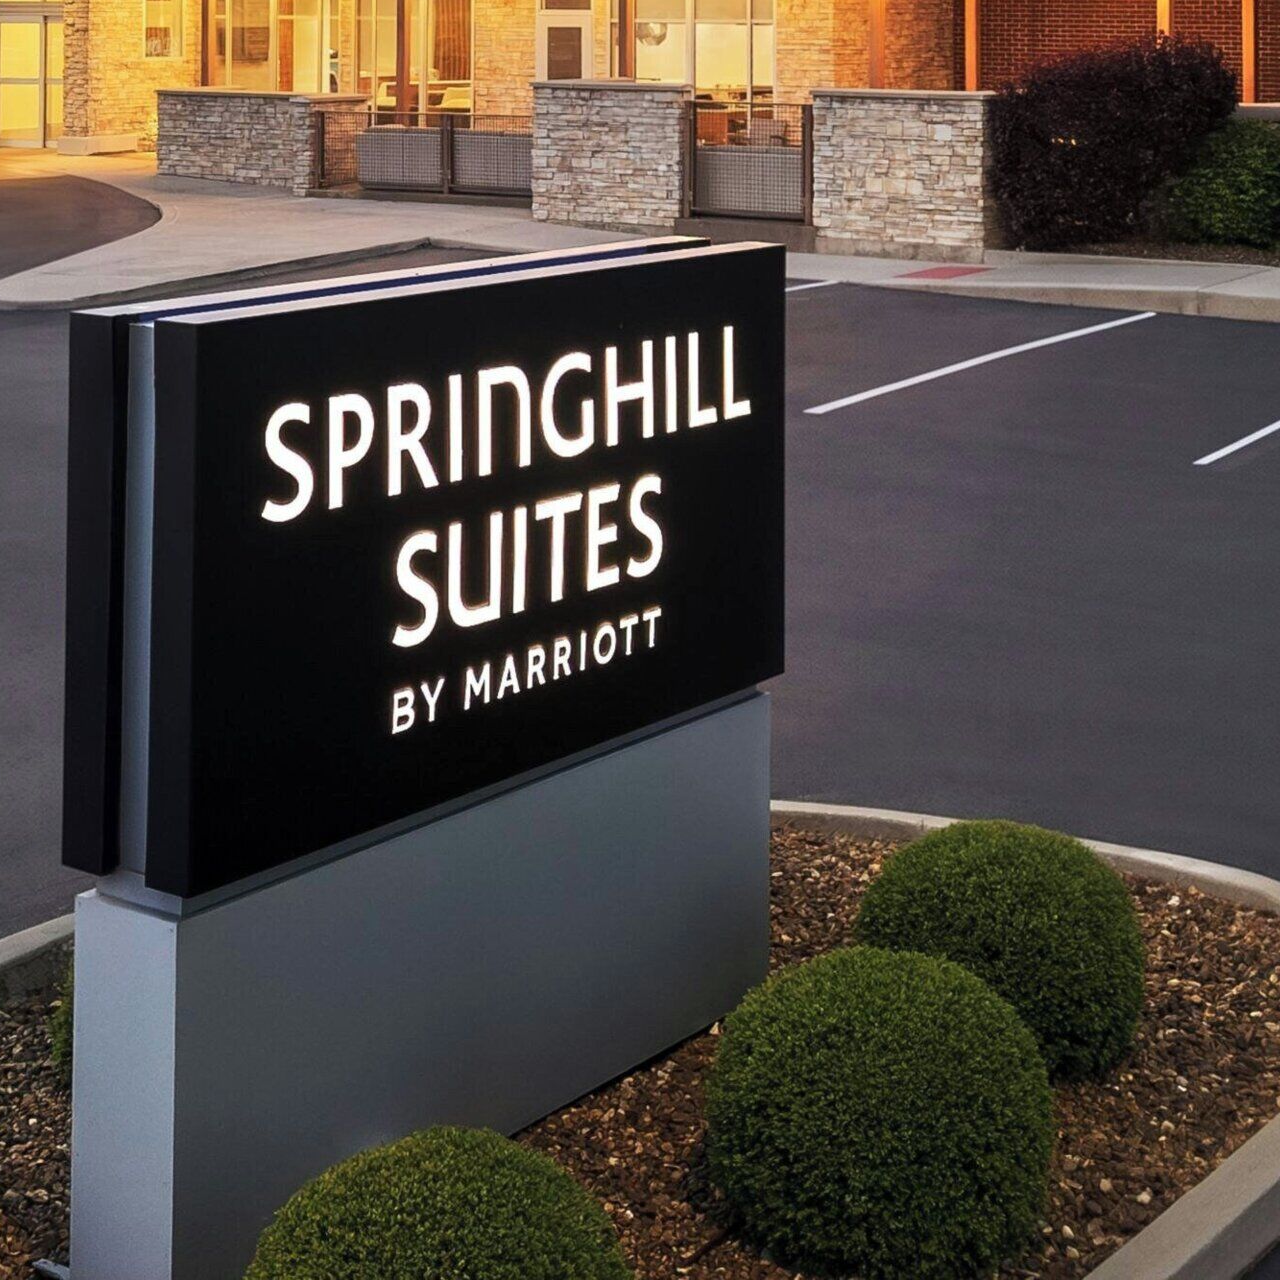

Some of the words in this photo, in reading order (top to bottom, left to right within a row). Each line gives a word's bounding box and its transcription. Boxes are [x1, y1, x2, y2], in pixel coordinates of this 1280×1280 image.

[261, 325, 752, 523] SPRINGHILL
[391, 473, 665, 648] SUITES
[391, 677, 446, 735] BY
[463, 606, 663, 711] MARRIOTT
